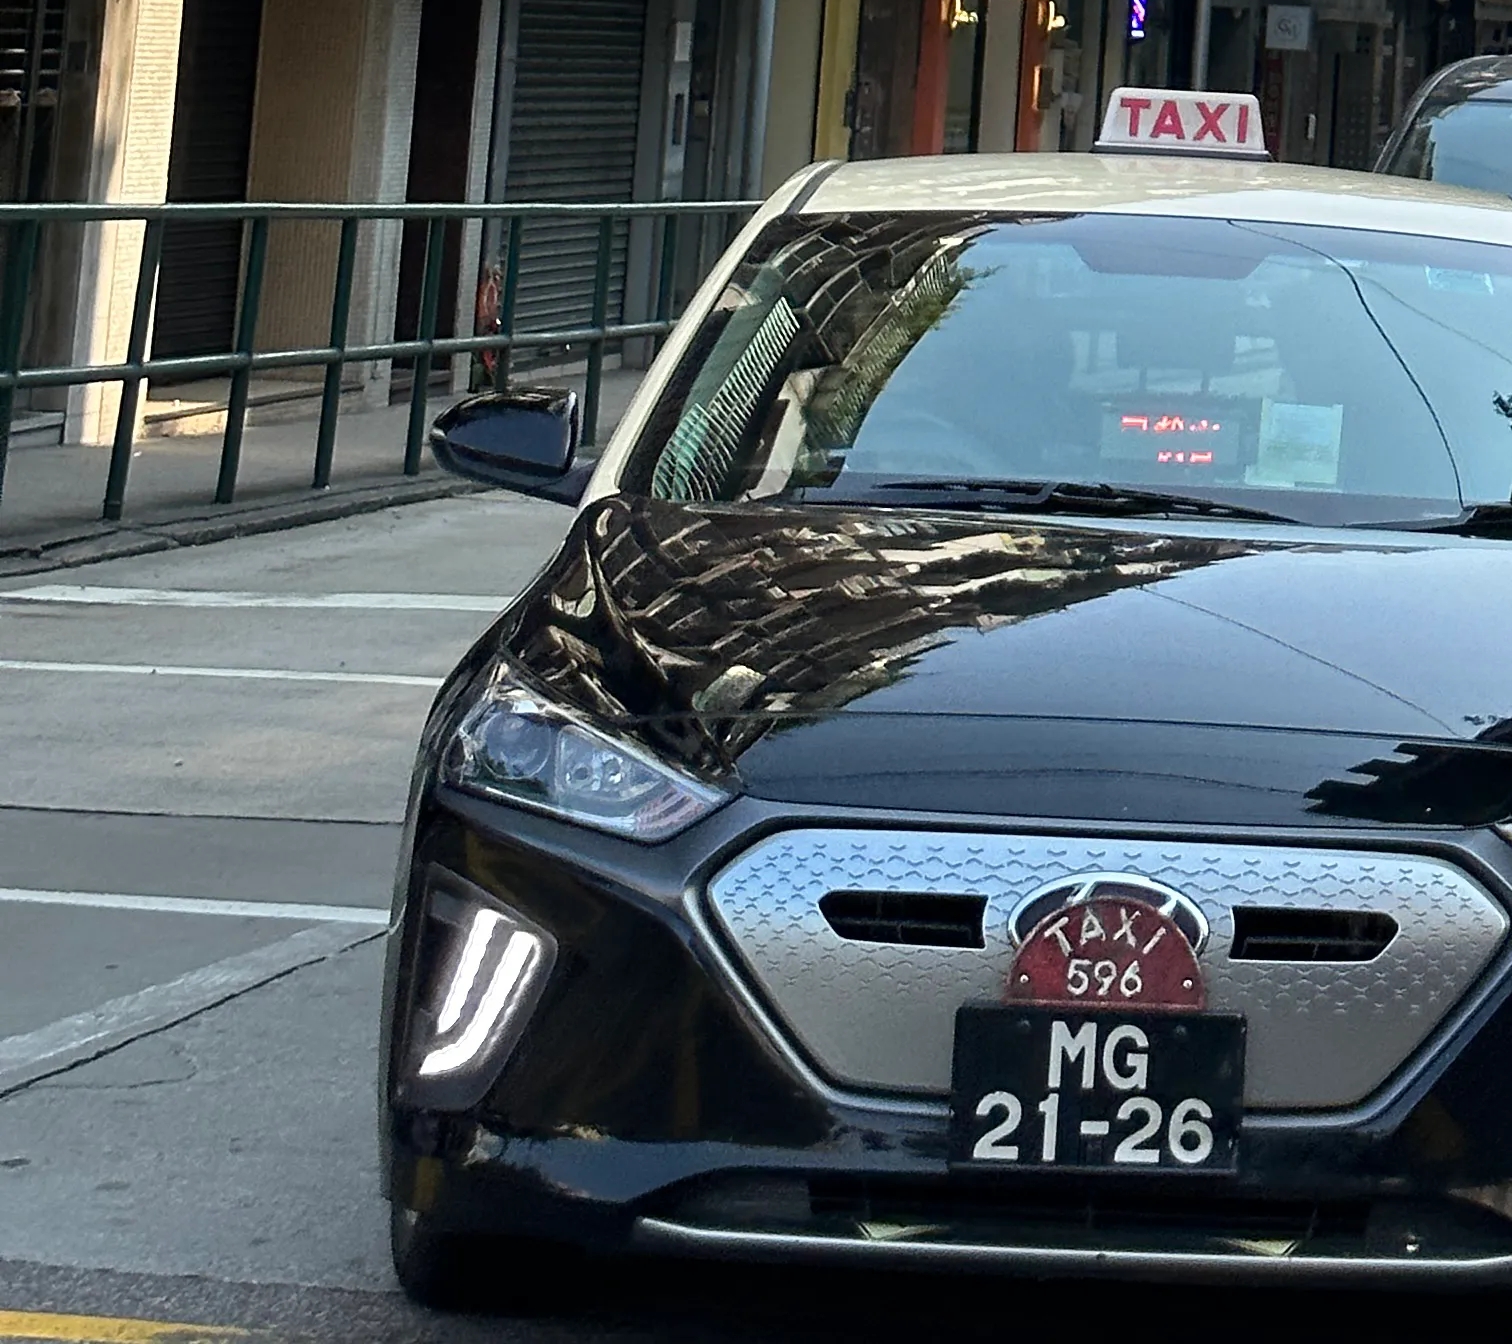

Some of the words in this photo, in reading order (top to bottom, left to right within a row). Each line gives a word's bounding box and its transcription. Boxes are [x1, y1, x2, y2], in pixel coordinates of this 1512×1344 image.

[1120, 97, 1250, 144] TAXI
[1043, 907, 1167, 957] TAXI
[1066, 958, 1143, 998] 596
[1046, 1020, 1150, 1091] MG
[972, 1090, 1214, 1164] 21-26
